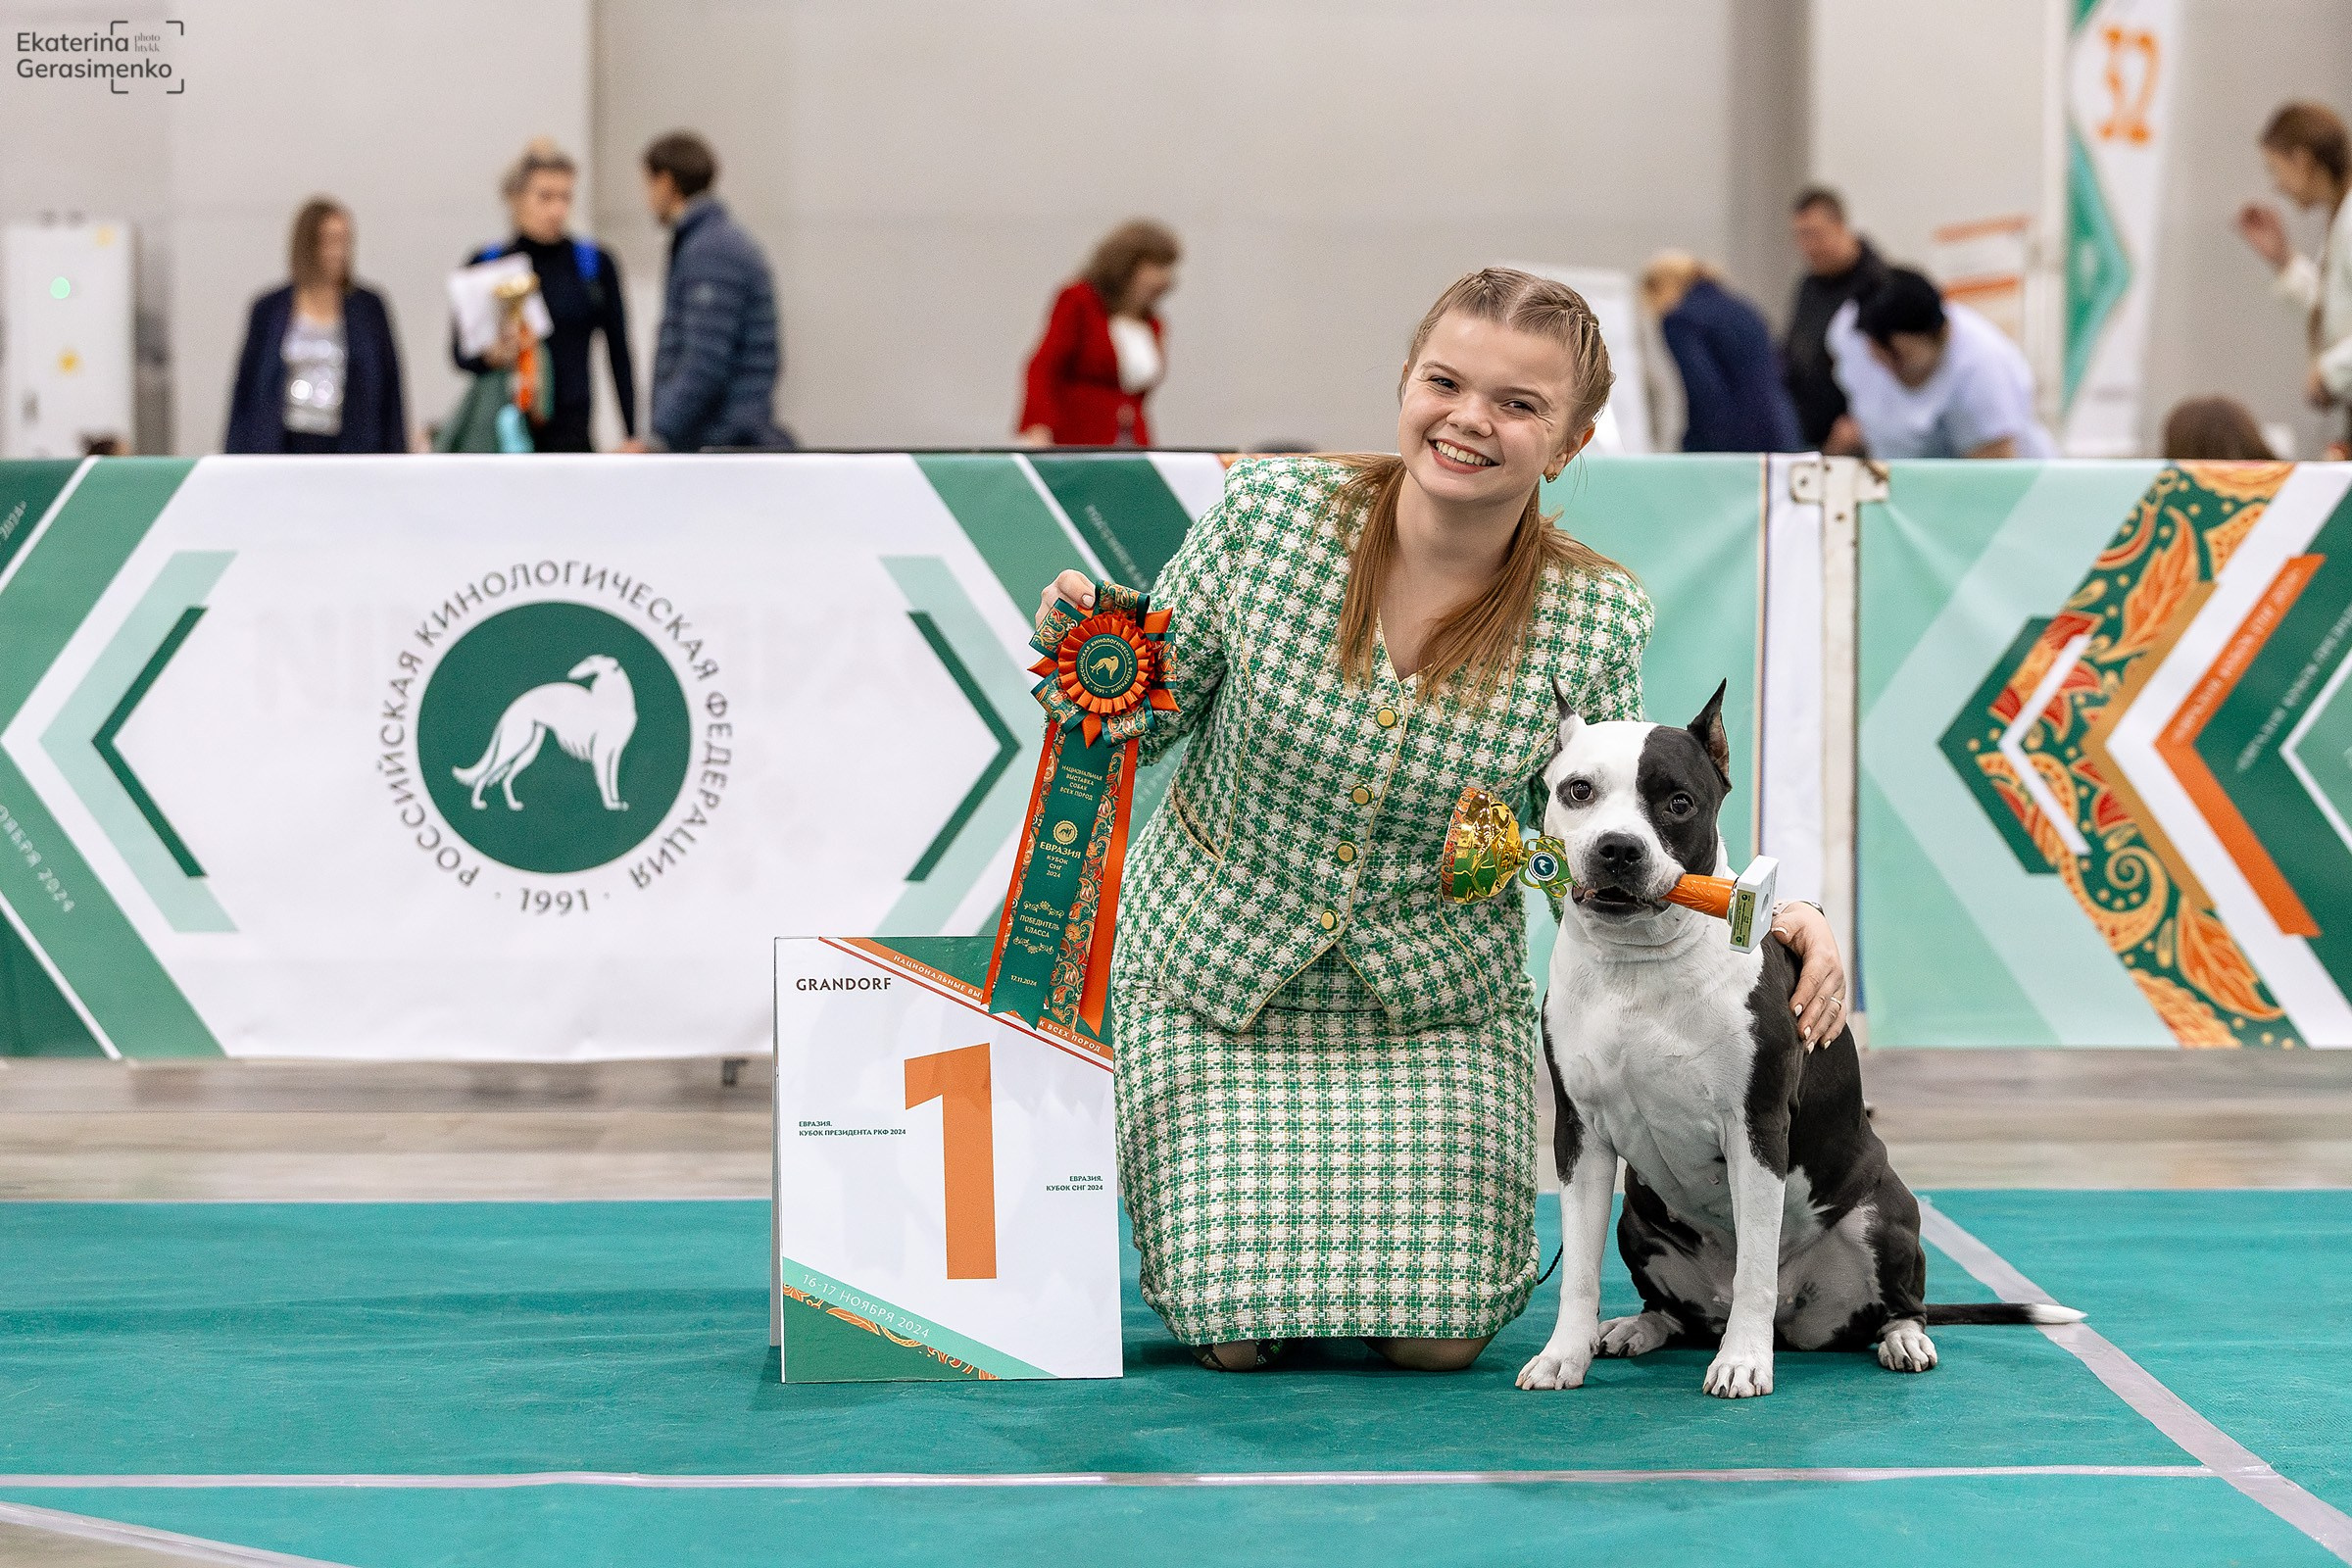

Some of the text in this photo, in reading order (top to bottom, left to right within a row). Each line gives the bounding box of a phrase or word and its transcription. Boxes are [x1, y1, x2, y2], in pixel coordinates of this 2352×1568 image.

[414, 560, 720, 681] КИНОЛОГИЧЕСКАЯ
[376, 650, 480, 889] РОССИЙСКАЯ
[1065, 772, 1095, 786] ВЫСТАВКА
[1069, 782, 1088, 791] СОБАК
[628, 690, 733, 890] ФЕДЕРАЦИЯ
[1059, 786, 1094, 802] ВСЕХ ПОРОД
[1040, 841, 1082, 859] ЕВРАЗИЯ
[1046, 855, 1068, 865] КУБОК
[1049, 862, 1062, 871] СНГ
[518, 887, 590, 915] 1991
[1019, 914, 1060, 931] ПОБЕДИТЕЛЬ
[1024, 925, 1050, 938] КЛАССА
[796, 977, 892, 991] GRANDORF
[893, 955, 965, 992] НАЦИОНАЛЬНЫЕ
[1048, 1022, 1069, 1038] ВСЕХ
[1071, 1033, 1101, 1054] ПОРОД
[905, 1042, 997, 1279] 1
[803, 1274, 930, 1339] 16-17 НОЯБРЯ 2024
